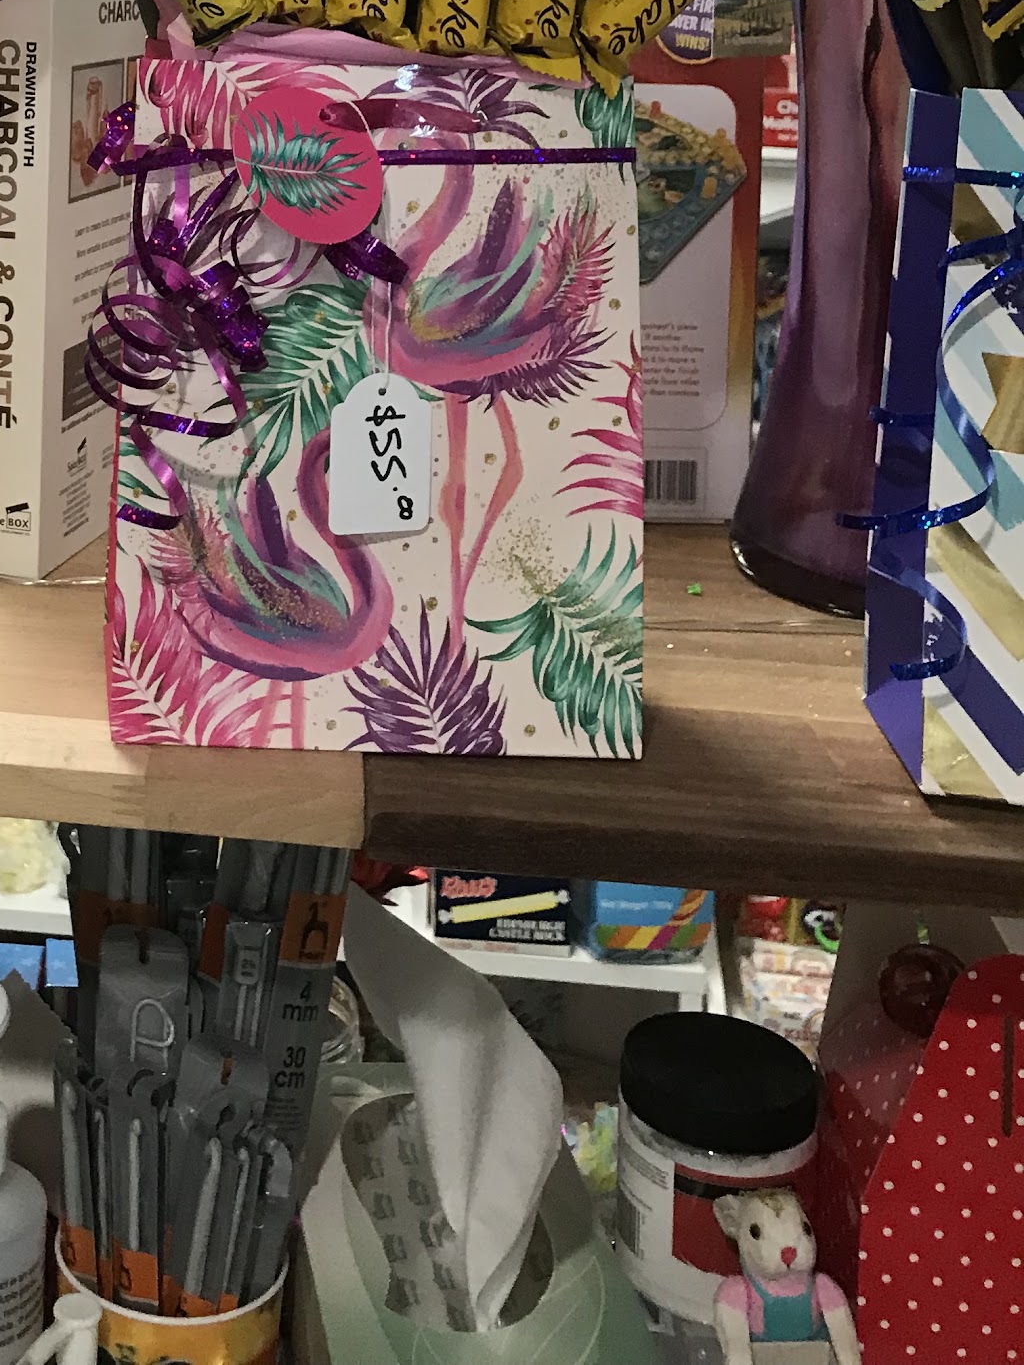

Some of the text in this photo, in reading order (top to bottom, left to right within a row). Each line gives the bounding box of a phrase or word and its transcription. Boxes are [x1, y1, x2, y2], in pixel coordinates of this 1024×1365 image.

[98, 0, 140, 24] CHARC
[23, 41, 37, 168] DRAWING WITH
[8, 517, 29, 529] BOX
[299, 980, 311, 1002] 4
[282, 1002, 319, 1022] mm
[283, 1046, 307, 1069] 30
[275, 1070, 305, 1089] cm
